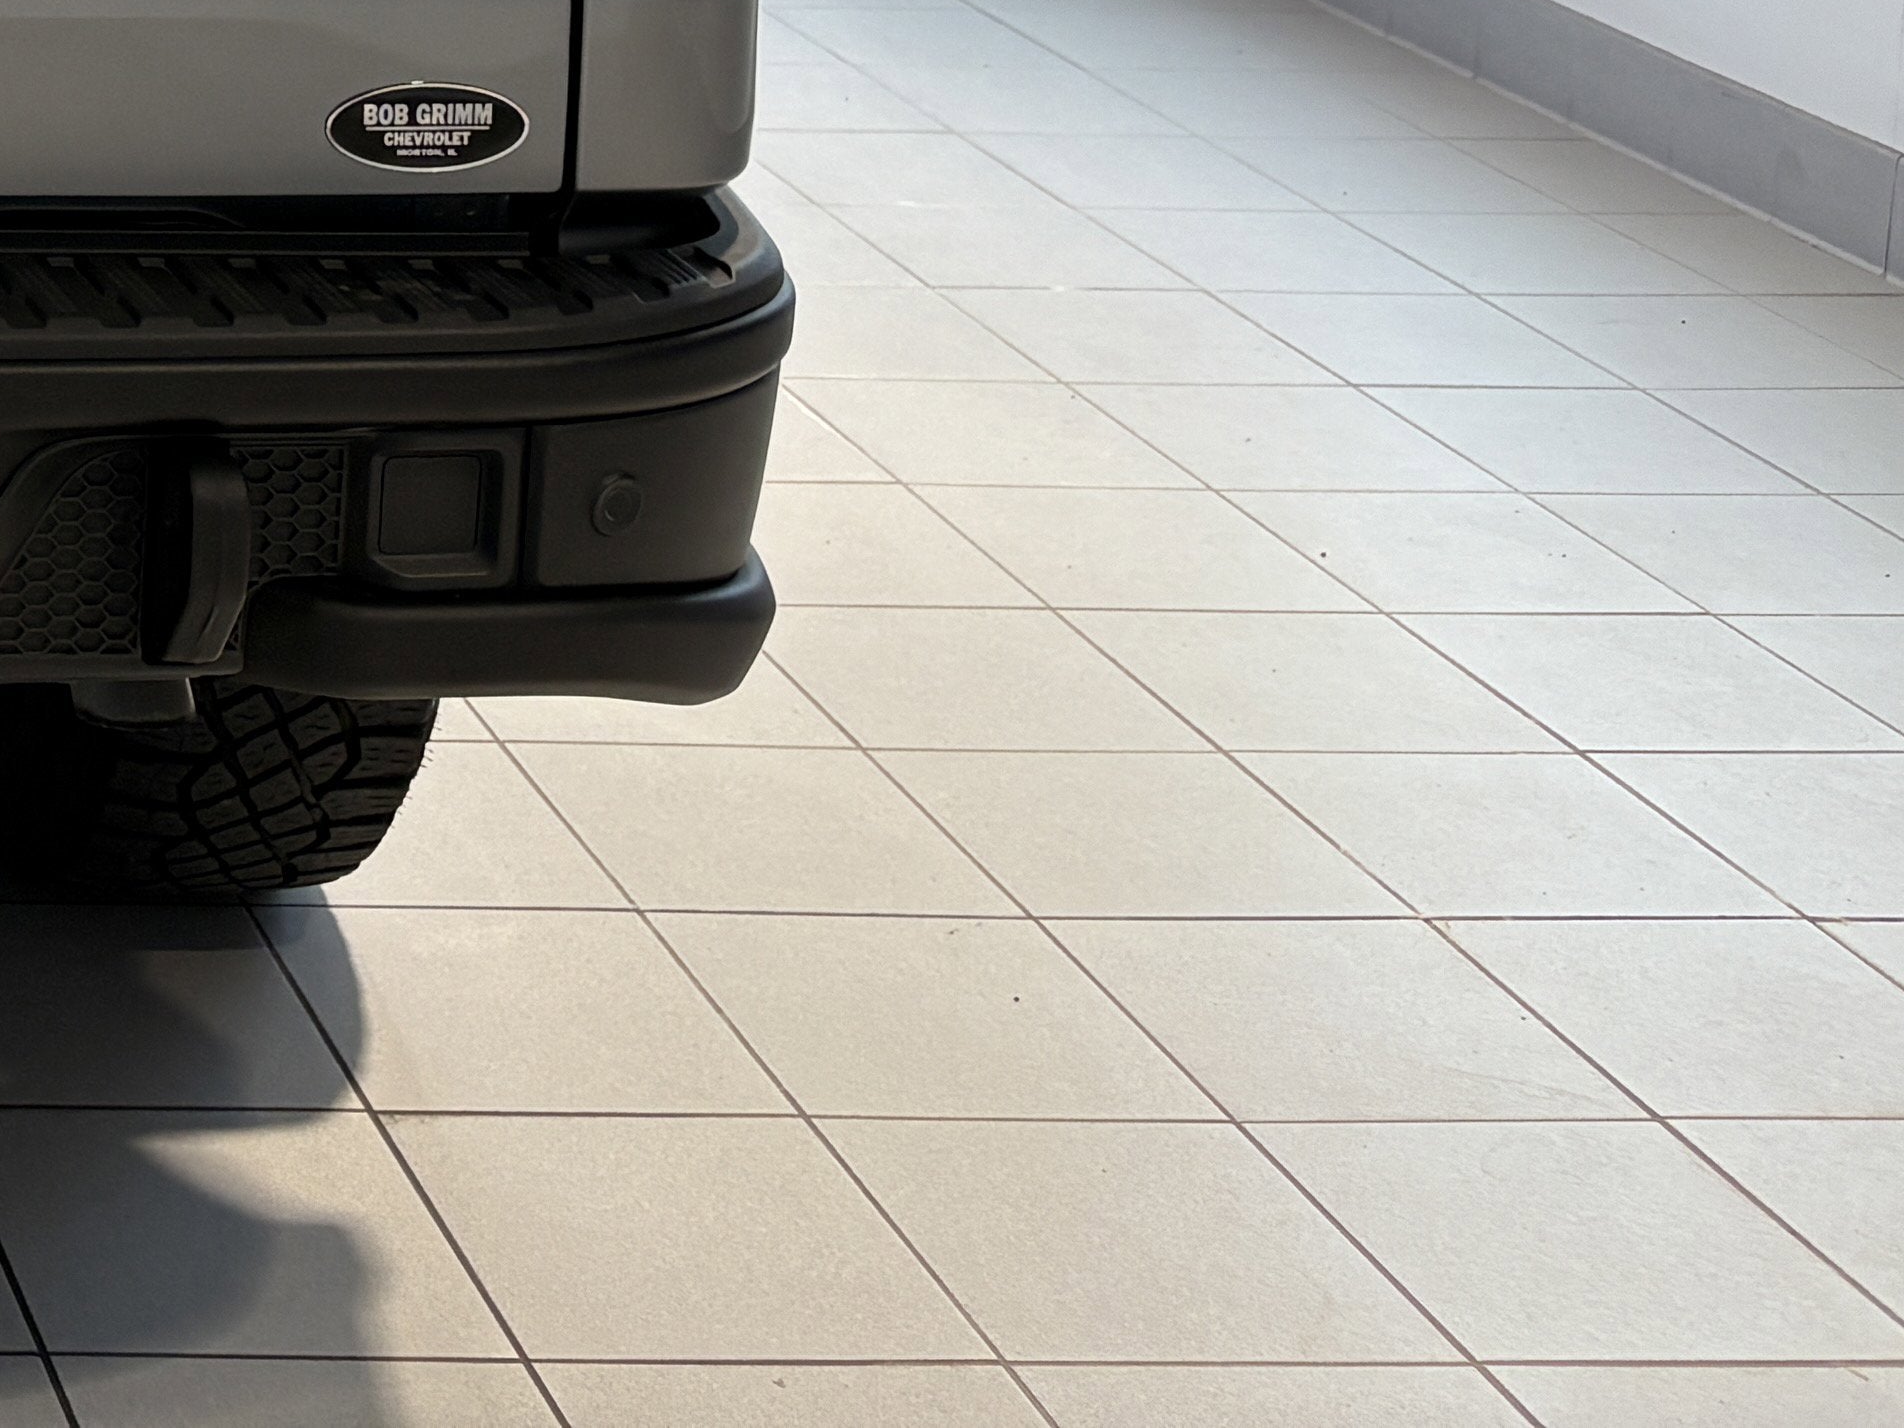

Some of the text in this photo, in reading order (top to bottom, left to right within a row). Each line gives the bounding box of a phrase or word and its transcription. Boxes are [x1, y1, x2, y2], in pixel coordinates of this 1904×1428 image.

[363, 103, 492, 125] BOB GRIMM
[383, 132, 471, 146] CHEVROLET
